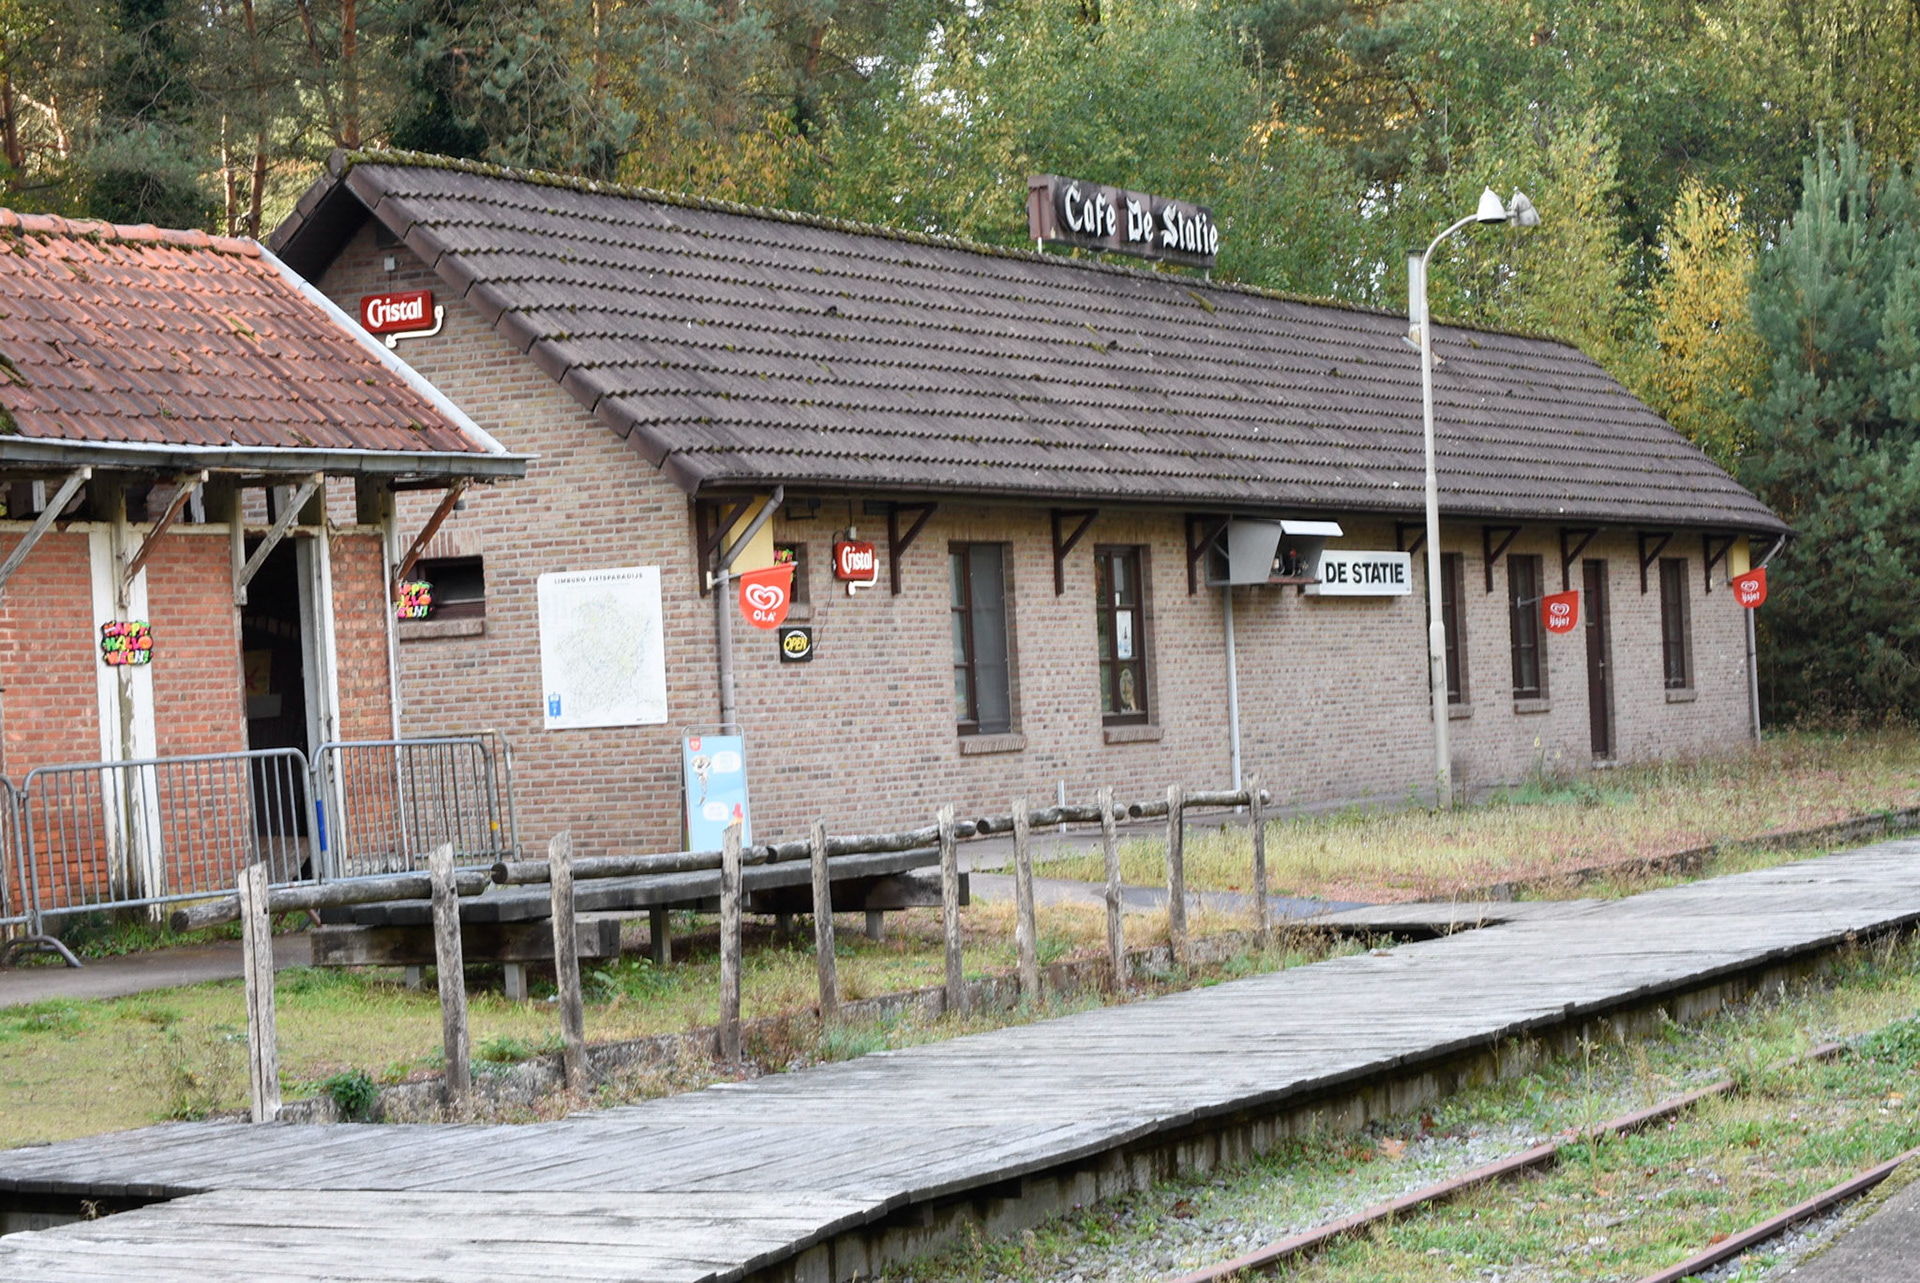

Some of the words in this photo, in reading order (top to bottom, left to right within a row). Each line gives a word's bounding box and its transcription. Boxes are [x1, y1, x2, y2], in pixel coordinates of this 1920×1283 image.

[1065, 181, 1116, 237] Cafe
[1126, 197, 1154, 242] De
[1161, 204, 1219, 256] Statie
[367, 297, 423, 328] Cristal
[842, 546, 872, 574] Cristal
[554, 576, 587, 584] LIMBURG
[589, 573, 643, 582] FIETSPARADIJS
[1325, 562, 1347, 584] DE
[1352, 562, 1404, 584] STATIE
[105, 635, 153, 651] HALLO
[783, 636, 808, 651] OPEN
